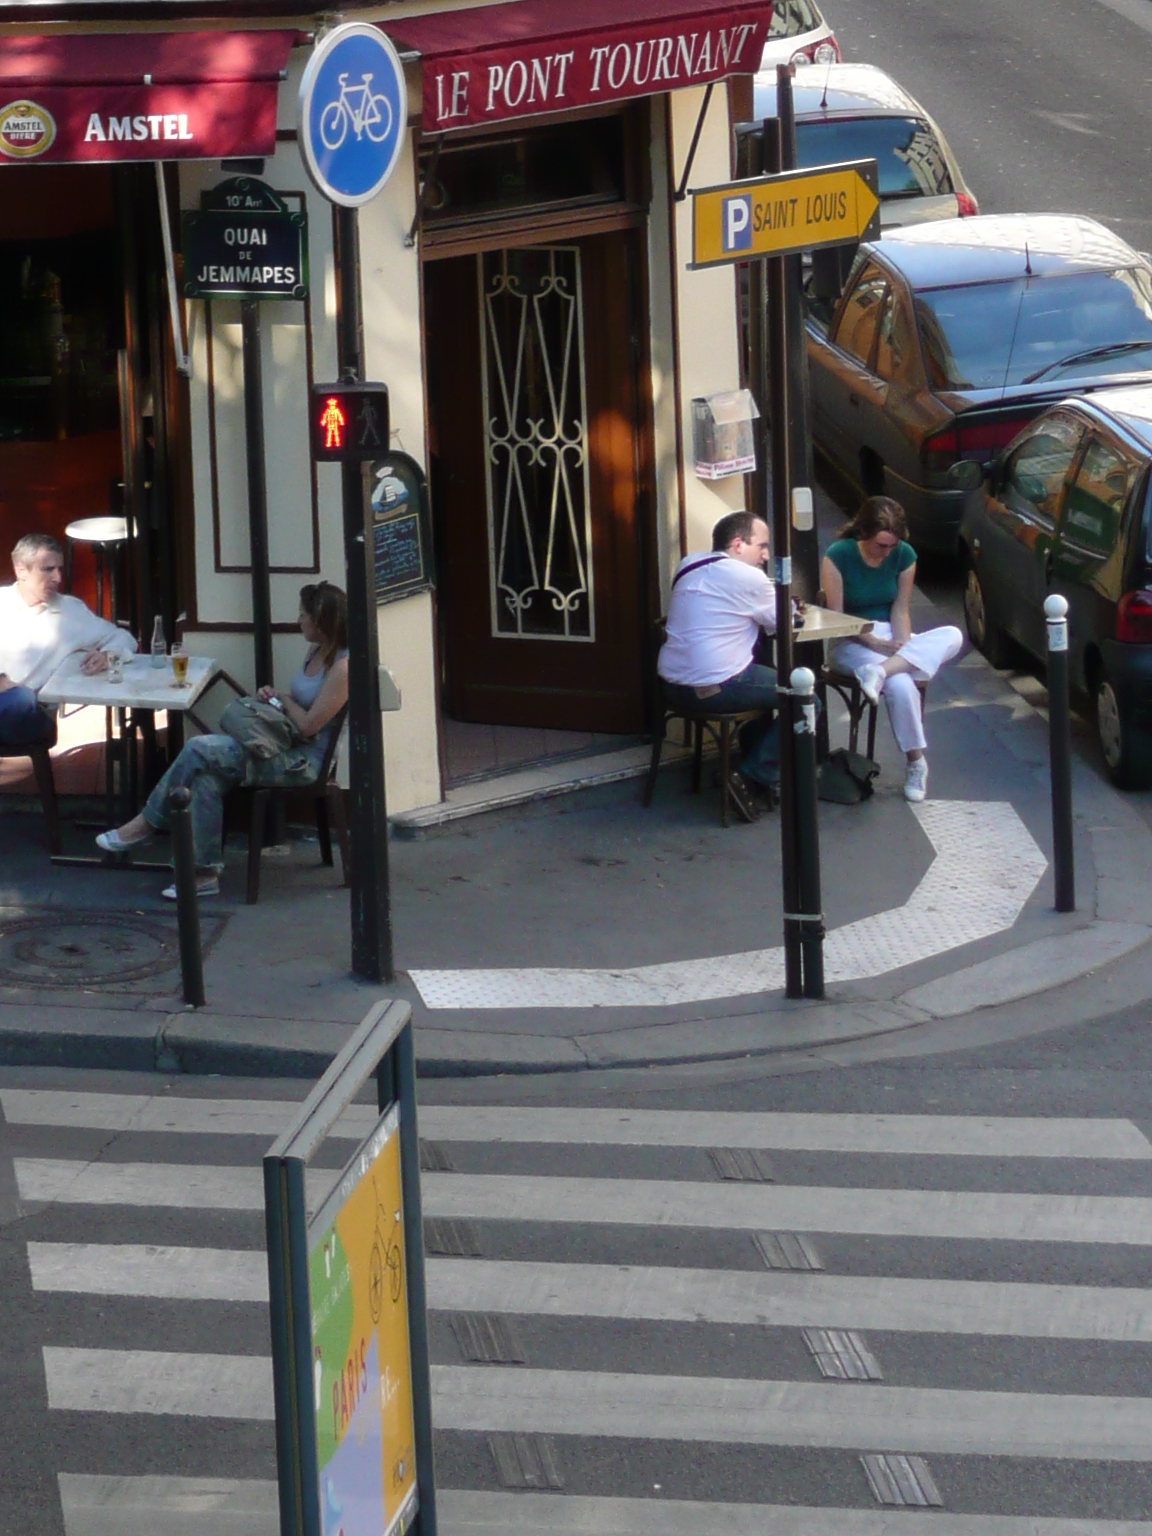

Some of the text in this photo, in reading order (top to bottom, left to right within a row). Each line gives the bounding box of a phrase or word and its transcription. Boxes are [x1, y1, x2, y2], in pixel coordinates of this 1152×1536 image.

[435, 24, 756, 121] LE PONT TOURNANT
[4, 121, 43, 131] AMSTEL
[84, 113, 193, 142] AMSTEL
[728, 193, 846, 249] P SAINT LOUIS
[224, 228, 267, 245] QUAI
[239, 251, 252, 260] DE
[197, 265, 295, 284] JEMMAPES
[332, 1337, 368, 1441] PARIS
